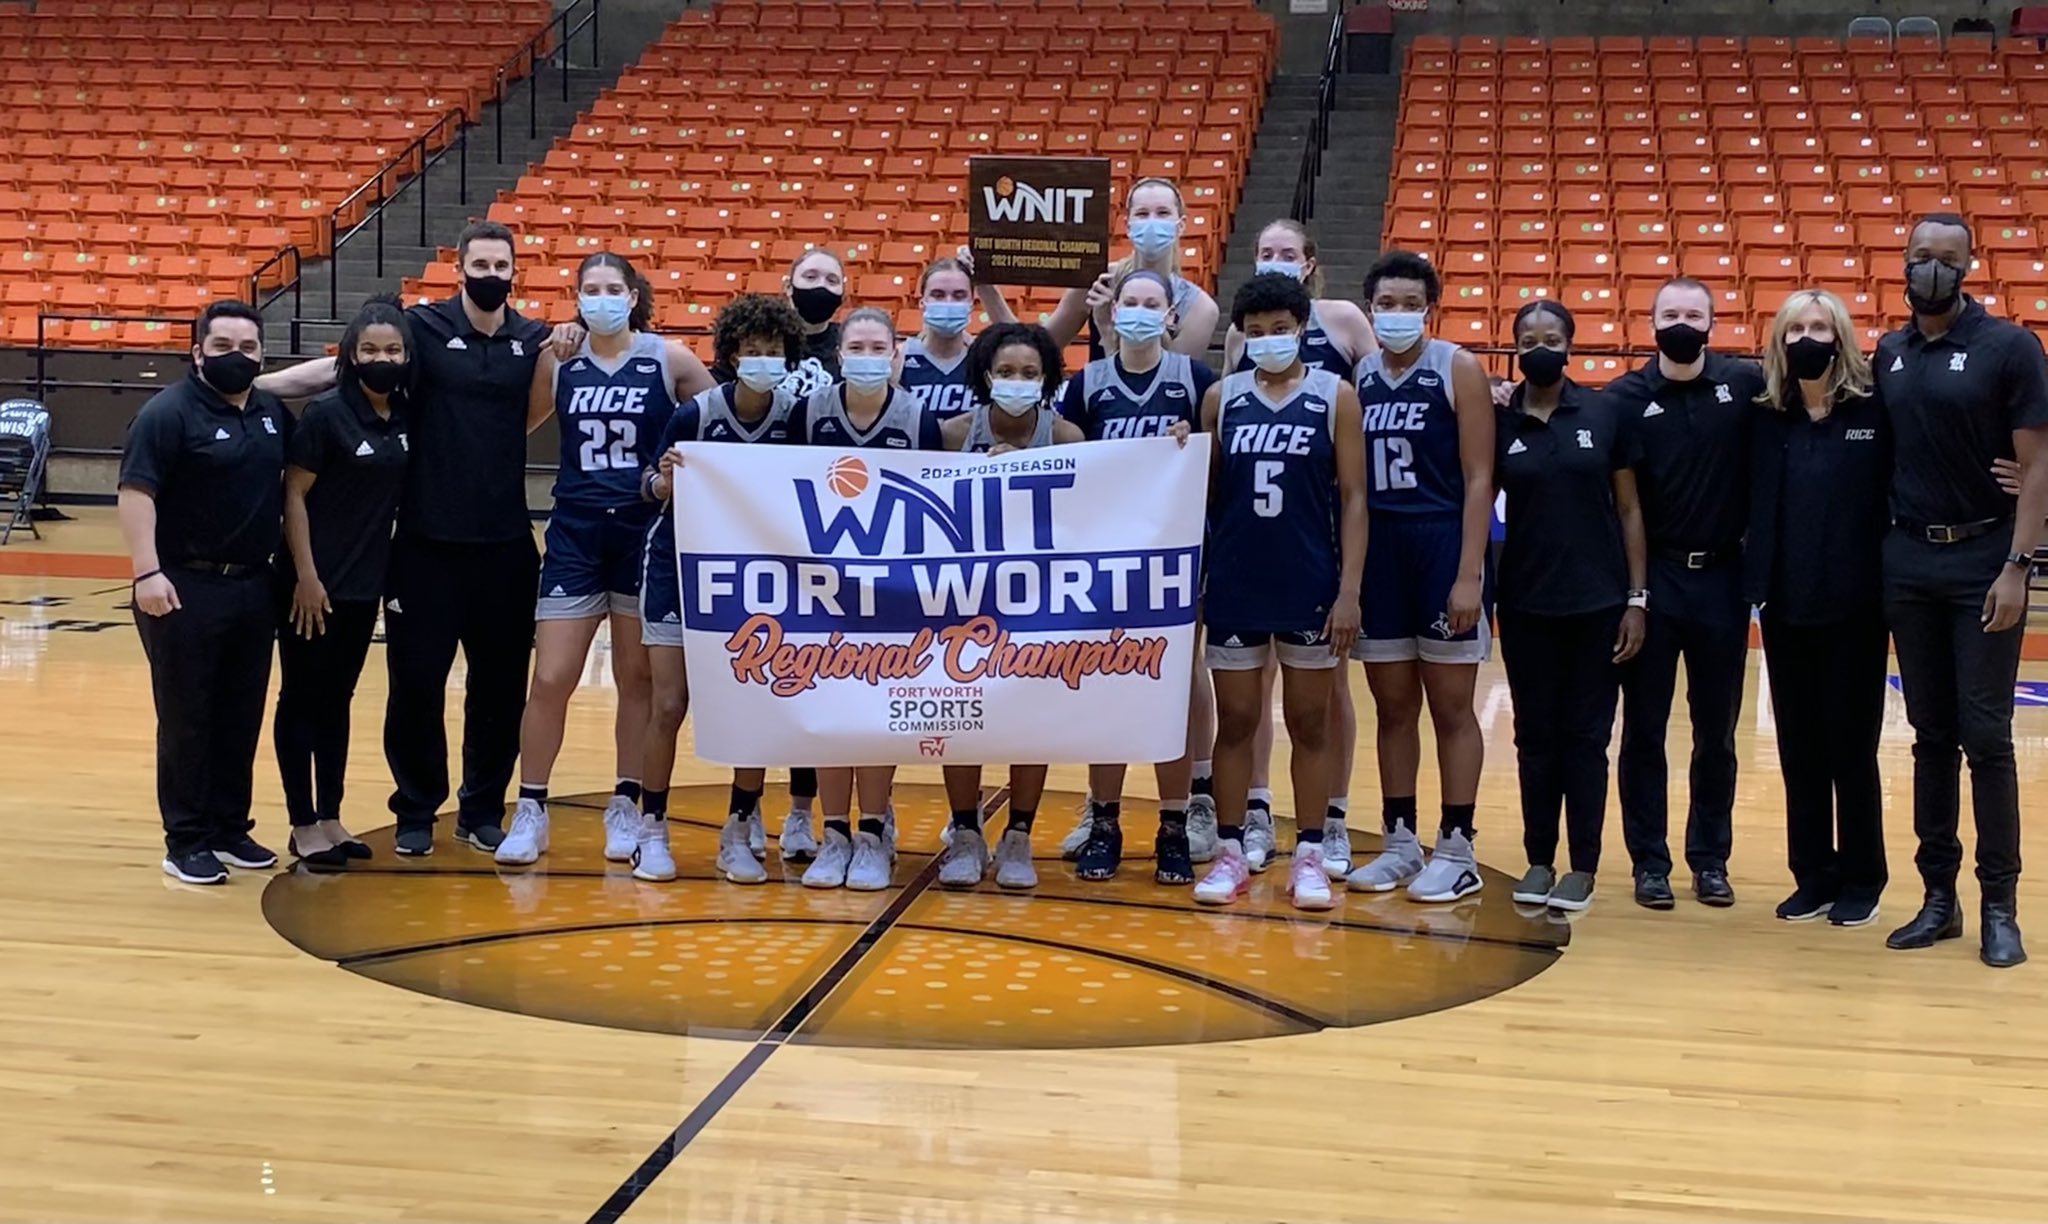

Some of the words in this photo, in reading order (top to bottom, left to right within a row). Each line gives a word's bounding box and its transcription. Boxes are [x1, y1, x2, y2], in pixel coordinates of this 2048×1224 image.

[983, 181, 1094, 224] WNIT
[974, 237, 992, 250] FORT
[994, 238, 1021, 251] WORTH
[1022, 239, 1059, 253] REGIONAL
[1060, 241, 1100, 254] CHAMPION
[991, 255, 1011, 267] 2021
[1012, 256, 1060, 269] POSTSEASON
[1061, 258, 1081, 270] WNIT
[568, 386, 649, 415] RICE
[1362, 402, 1430, 431] RICE
[578, 419, 639, 472] 22
[1230, 423, 1316, 456] RICE
[1845, 429, 1875, 441] RICE
[921, 468, 961, 480] 2021
[967, 457, 1076, 476] POSTSEASON
[1373, 437, 1418, 491] 12
[1253, 460, 1285, 518] 5
[794, 468, 1076, 555] WNIT
[698, 559, 889, 617] FORT
[912, 553, 1192, 617] WORTH
[725, 613, 934, 697] Regional
[938, 615, 1168, 691] Champion
[888, 687, 925, 698] FORT
[929, 686, 984, 698] WORTH
[889, 700, 984, 719] SPORTS
[888, 720, 984, 732] COMMISSION
